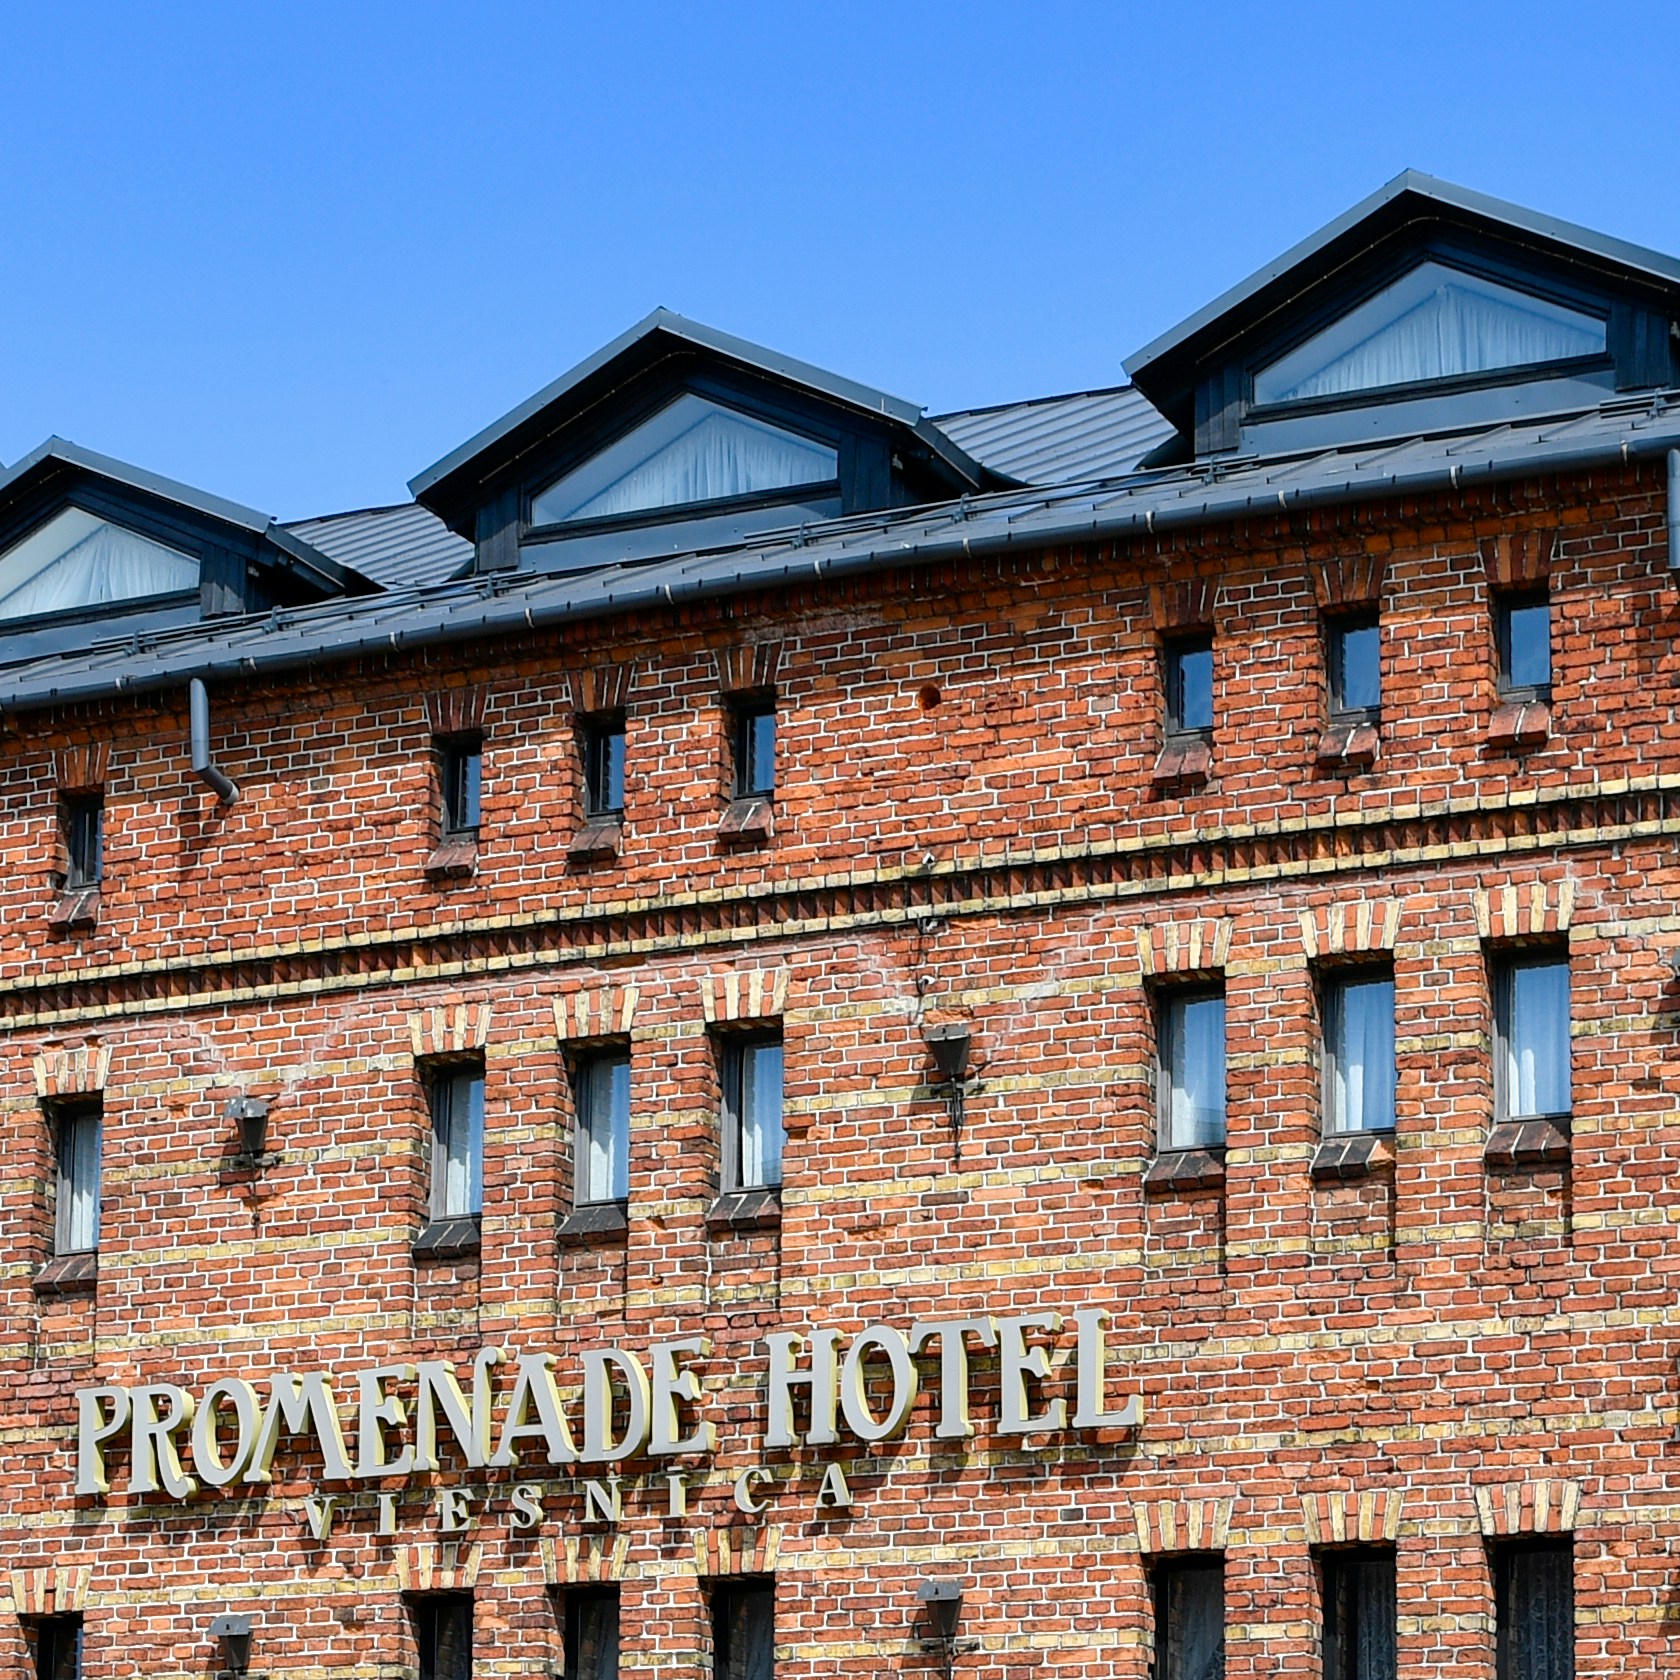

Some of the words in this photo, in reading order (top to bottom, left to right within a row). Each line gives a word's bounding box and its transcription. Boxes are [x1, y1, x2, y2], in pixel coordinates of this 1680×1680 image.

[75, 1336, 717, 1500] PROMENADE
[764, 1307, 1144, 1447] HOTEL
[305, 1463, 853, 1540] VIESNĪCA
